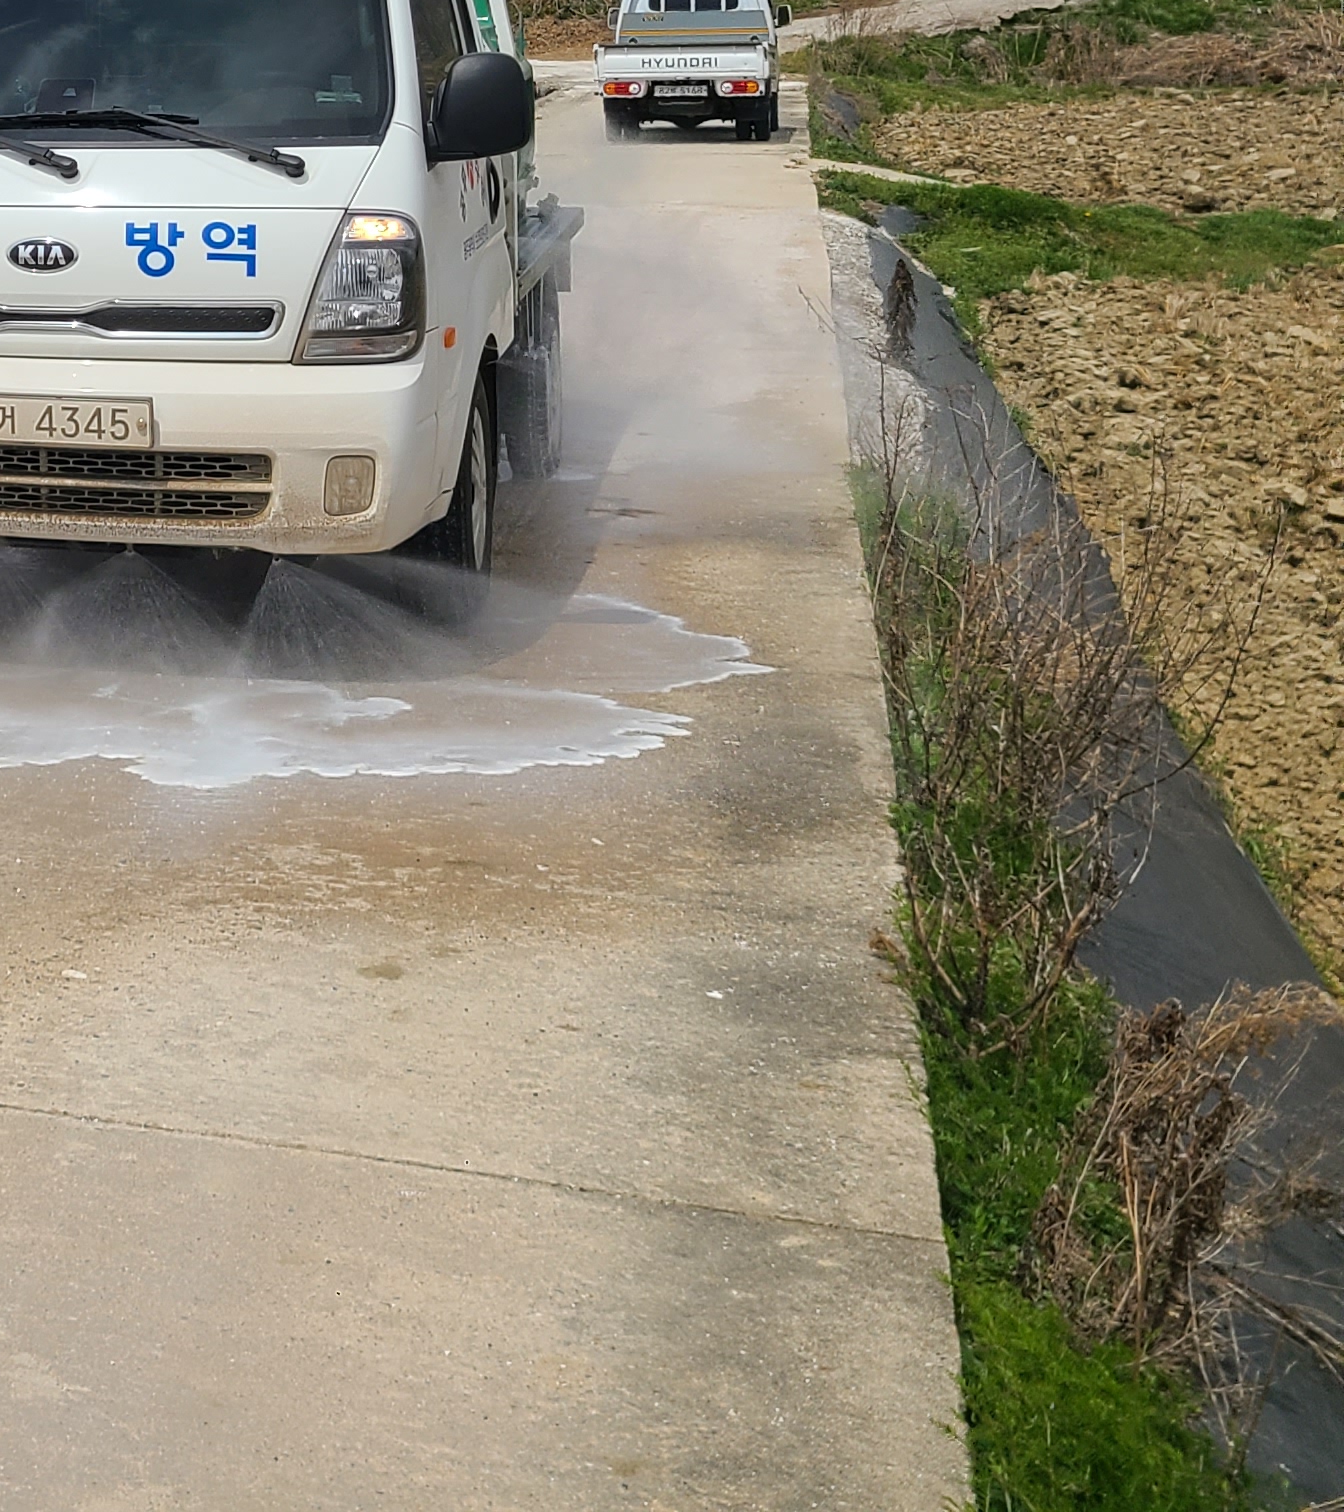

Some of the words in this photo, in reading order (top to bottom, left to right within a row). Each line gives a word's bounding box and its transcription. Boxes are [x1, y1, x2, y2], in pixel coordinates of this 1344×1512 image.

[641, 57, 718, 68] HYUNDAI
[17, 244, 66, 266] KIA
[125, 221, 257, 277] 방역
[34, 405, 130, 440] 4345
